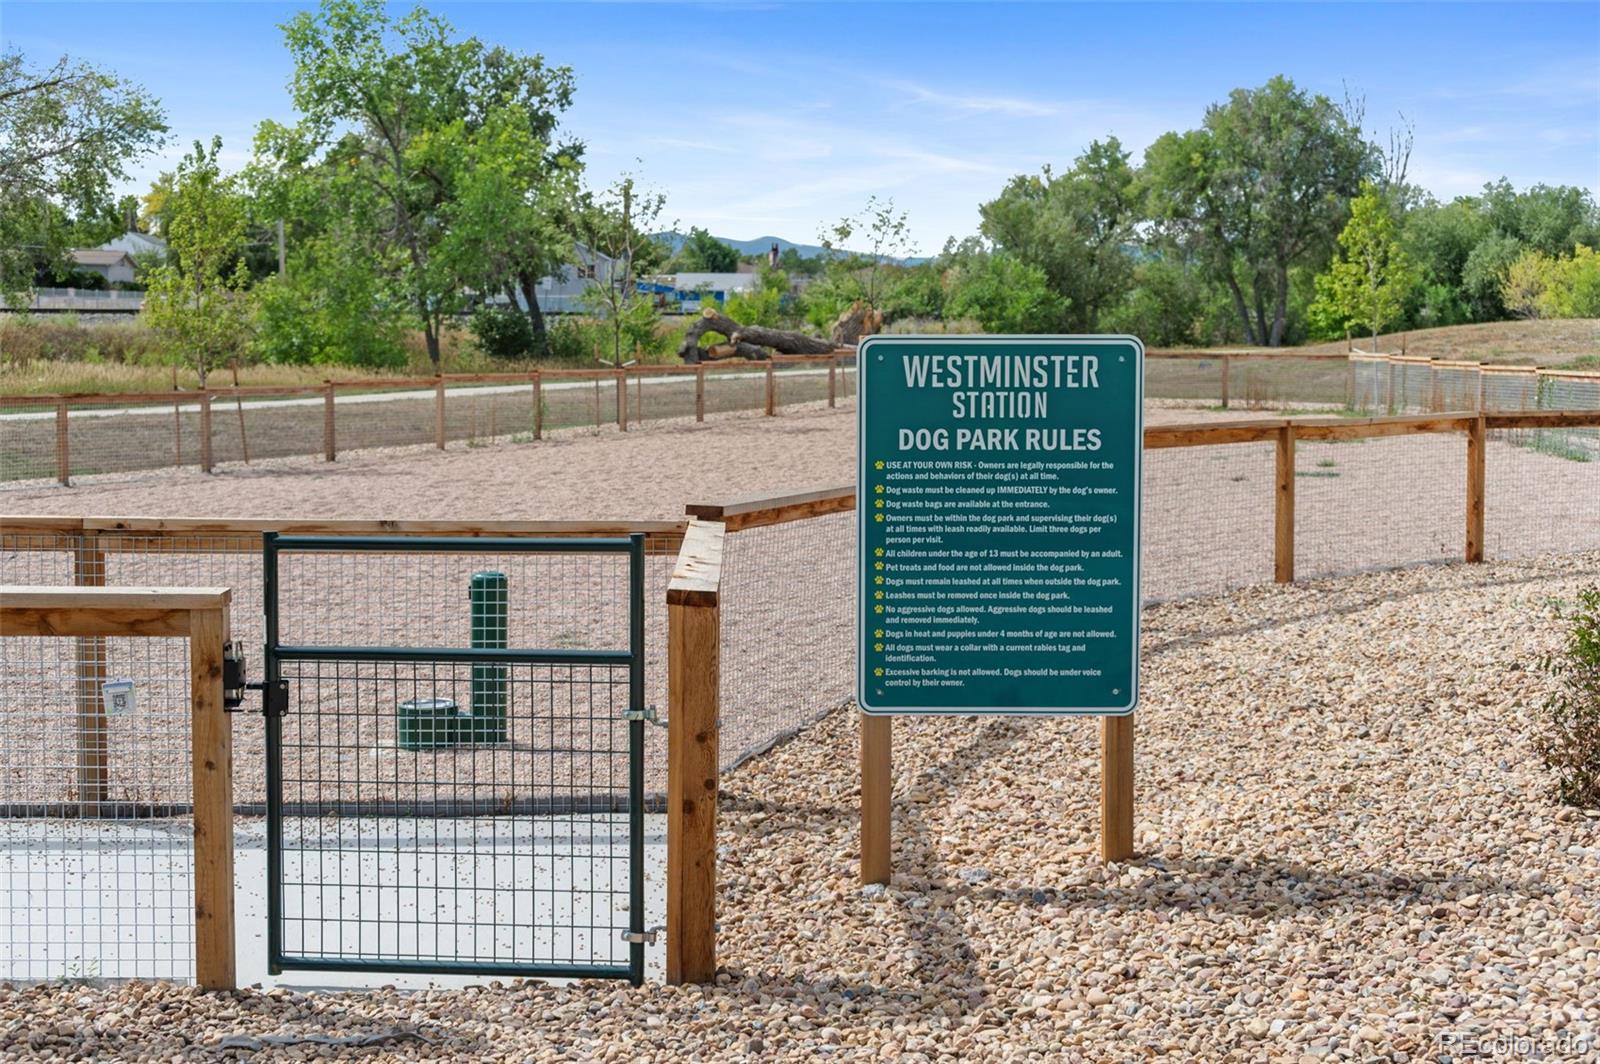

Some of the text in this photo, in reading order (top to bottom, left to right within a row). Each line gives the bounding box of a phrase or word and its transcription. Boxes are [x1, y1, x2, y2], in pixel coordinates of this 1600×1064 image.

[902, 355, 1099, 388] WESTMINSTER
[952, 391, 1047, 418] STATION
[899, 428, 1102, 451] DOG PARK RULES
[1020, 462, 1045, 470] legally
[1046, 462, 1088, 470] responsible
[994, 473, 1019, 481] dog(s)
[886, 486, 901, 495] Dog
[1049, 487, 1058, 495] by
[1072, 487, 1092, 495] dog's
[886, 500, 901, 509] Dog
[925, 500, 943, 509] bags
[982, 514, 996, 523] dog
[997, 514, 1014, 523] park
[1031, 515, 1073, 523] supervising
[1093, 515, 1117, 523] dog(s)
[966, 525, 991, 534] readily
[1070, 526, 1088, 534] dogs
[1030, 550, 1080, 558] accompanied
[1081, 550, 1089, 558] by
[1050, 564, 1064, 572] dog
[1065, 564, 1083, 572] park.
[885, 578, 904, 586] Dogs
[1087, 578, 1101, 586] dog
[1102, 578, 1121, 586] park.
[1036, 592, 1050, 600] dog
[1051, 592, 1070, 600] park.
[897, 606, 935, 614] aggressive
[937, 606, 955, 614] dogs
[988, 605, 1027, 614] Aggressive
[1028, 606, 1046, 614] dogs
[933, 616, 980, 624] immediately.
[896, 644, 914, 652] dogs
[1058, 644, 1071, 652] tag
[921, 668, 949, 677] barking
[1004, 668, 1022, 677] Dogs
